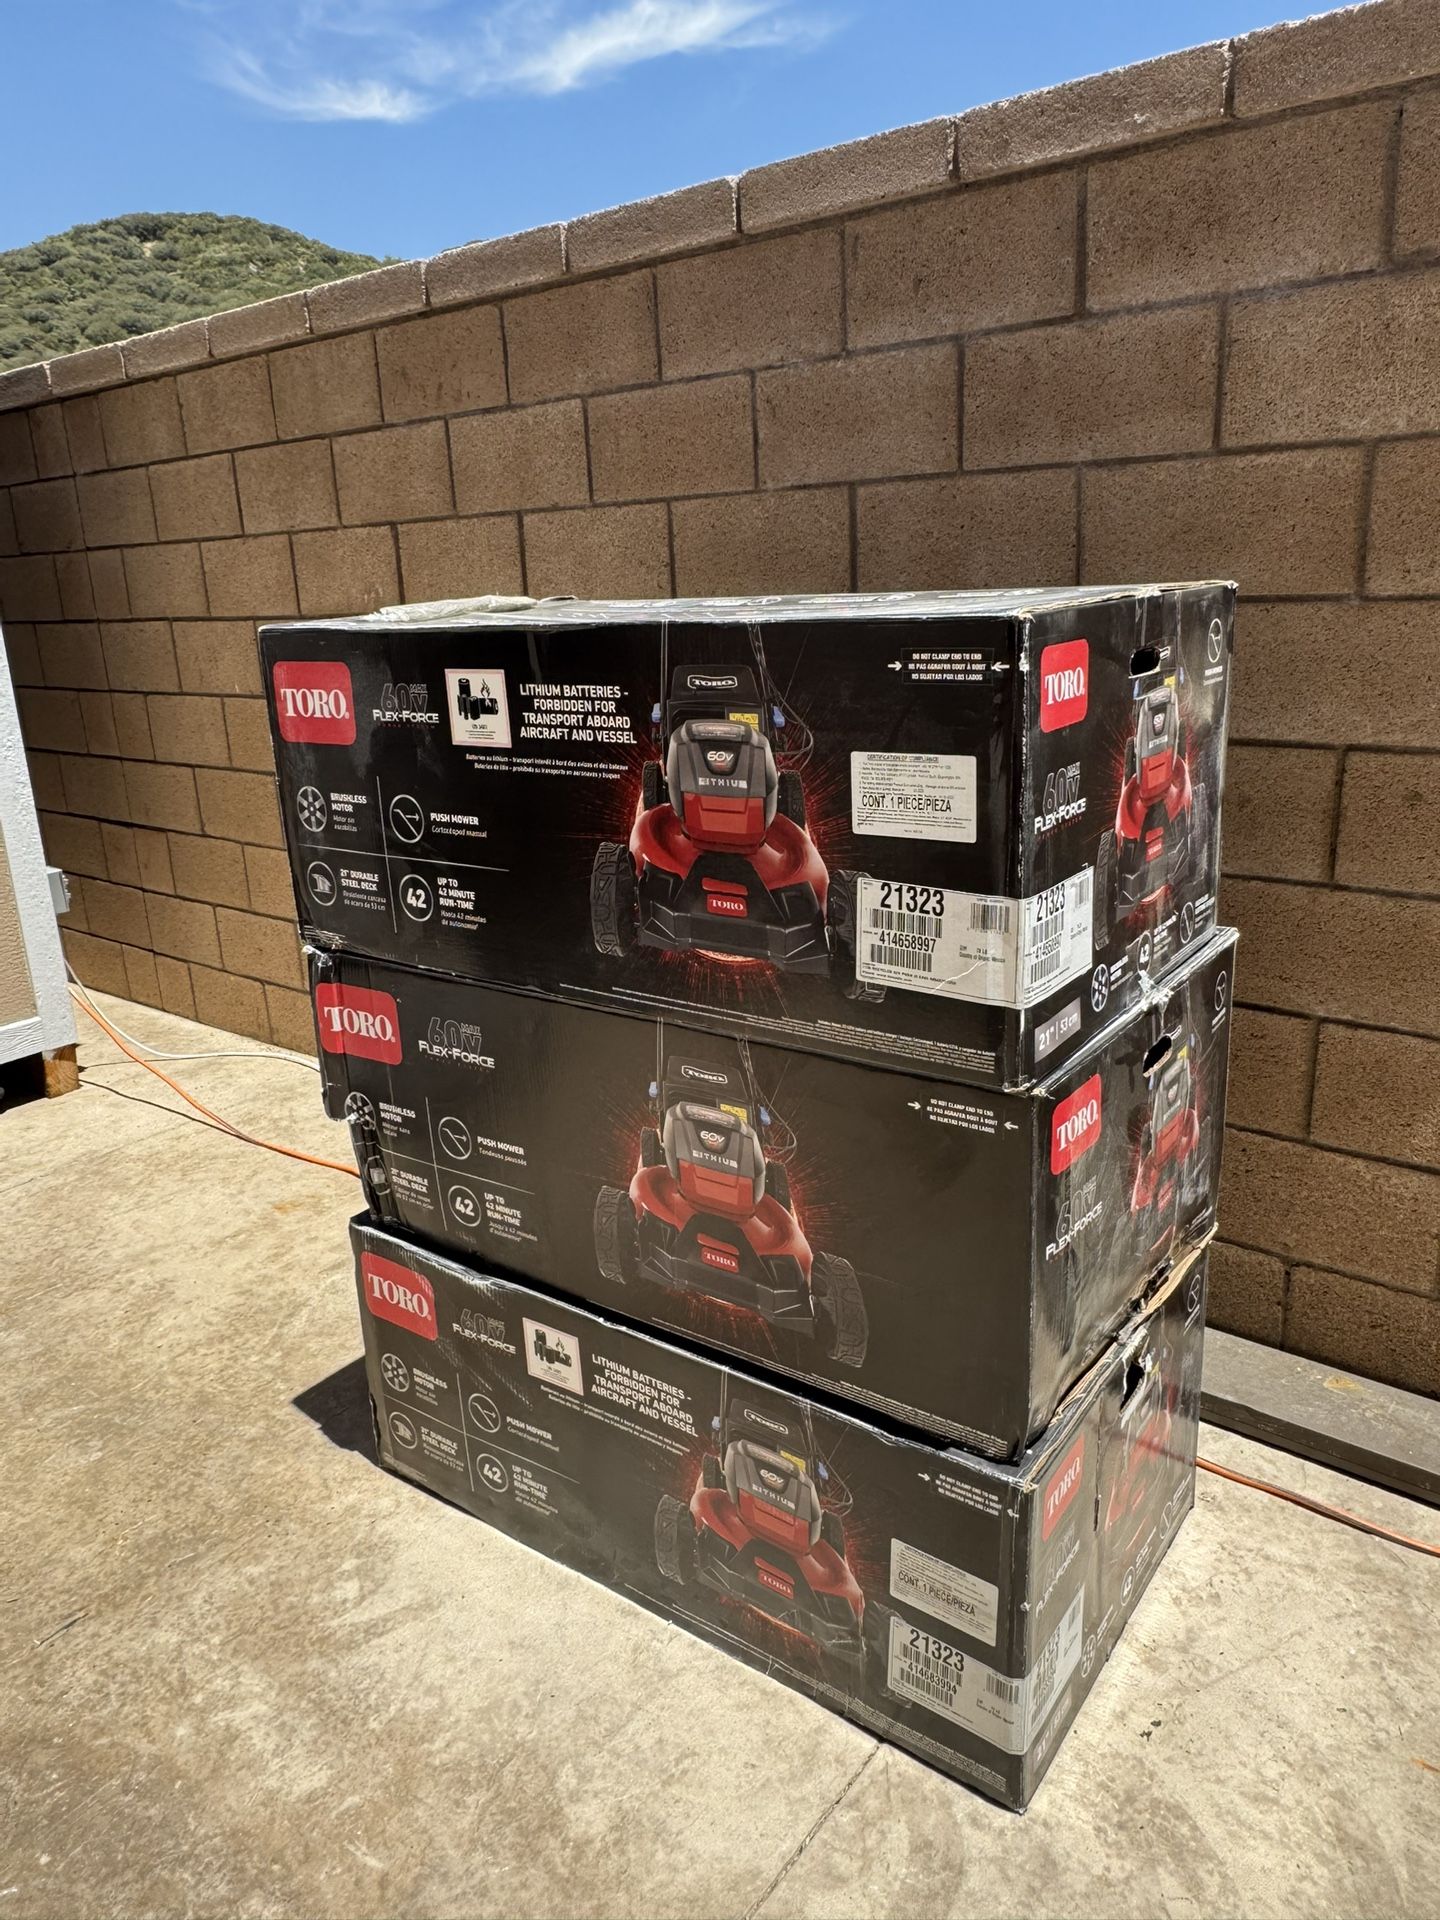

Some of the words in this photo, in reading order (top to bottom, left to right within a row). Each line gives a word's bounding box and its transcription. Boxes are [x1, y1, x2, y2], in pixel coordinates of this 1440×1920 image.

[520, 684, 561, 696] LITHIUM
[563, 685, 621, 698] BATTERIES
[534, 698, 592, 712] FORBIDDEN
[595, 700, 616, 713] FOR
[523, 712, 584, 726] TRANSPORT
[587, 714, 631, 728] ABOARD
[520, 726, 569, 740] AIRCRAFT
[572, 729, 594, 741] AND
[596, 730, 637, 744] VESSEL
[862, 795, 889, 808] CONT.
[890, 796, 895, 808] 1
[898, 796, 952, 812] PIECE/PIEZA
[430, 812, 450, 822] PUSH
[451, 814, 479, 825] MOWER
[437, 877, 447, 886] UP
[448, 878, 458, 887] TO
[406, 888, 427, 909] 42
[448, 889, 476, 900] MINUTE
[880, 882, 944, 917] 21323
[1036, 882, 1066, 922] 21323
[879, 930, 937, 953] 414658997
[418, 1040, 495, 1068] FLEX-FORCE
[477, 1136, 497, 1148] PUSH
[497, 1141, 525, 1155] MOWER
[455, 1197, 475, 1216] 42
[592, 1353, 630, 1376] LITHIUM
[632, 1370, 685, 1399] BATTERIES
[605, 1369, 658, 1399] FORBIDDEN
[660, 1392, 680, 1408] FOR
[594, 1374, 650, 1405] TRANSPORT
[653, 1400, 693, 1424] ABOARD
[591, 1384, 637, 1409] AIRCRAFT
[639, 1404, 659, 1419] AND
[660, 1413, 699, 1437] VESSEL
[483, 1464, 503, 1484] 42
[910, 1628, 964, 1672] 21323
